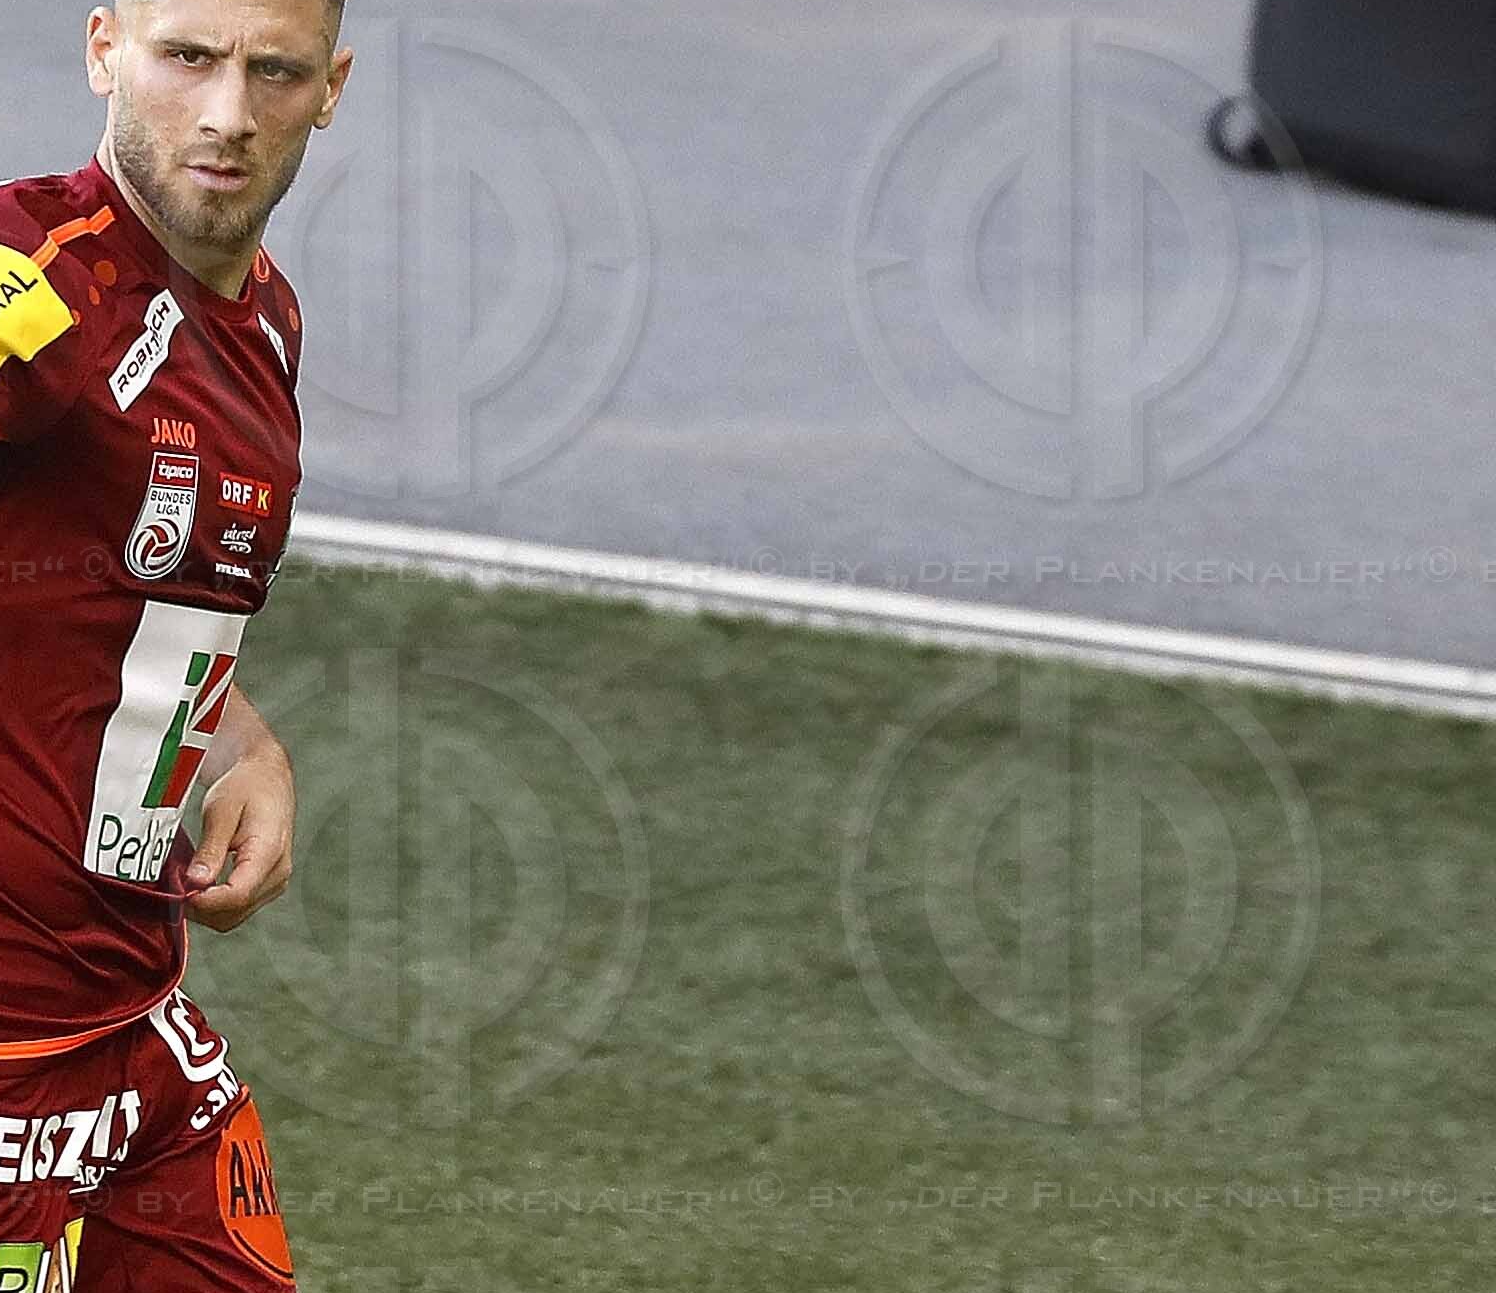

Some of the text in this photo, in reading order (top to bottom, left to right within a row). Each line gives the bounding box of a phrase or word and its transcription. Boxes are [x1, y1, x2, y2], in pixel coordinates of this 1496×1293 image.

[150, 417, 197, 450] JAKO
[157, 460, 194, 480] tipico
[149, 489, 192, 506] BUNDES
[221, 478, 270, 511] ORF K
[155, 504, 181, 516] LIGA
